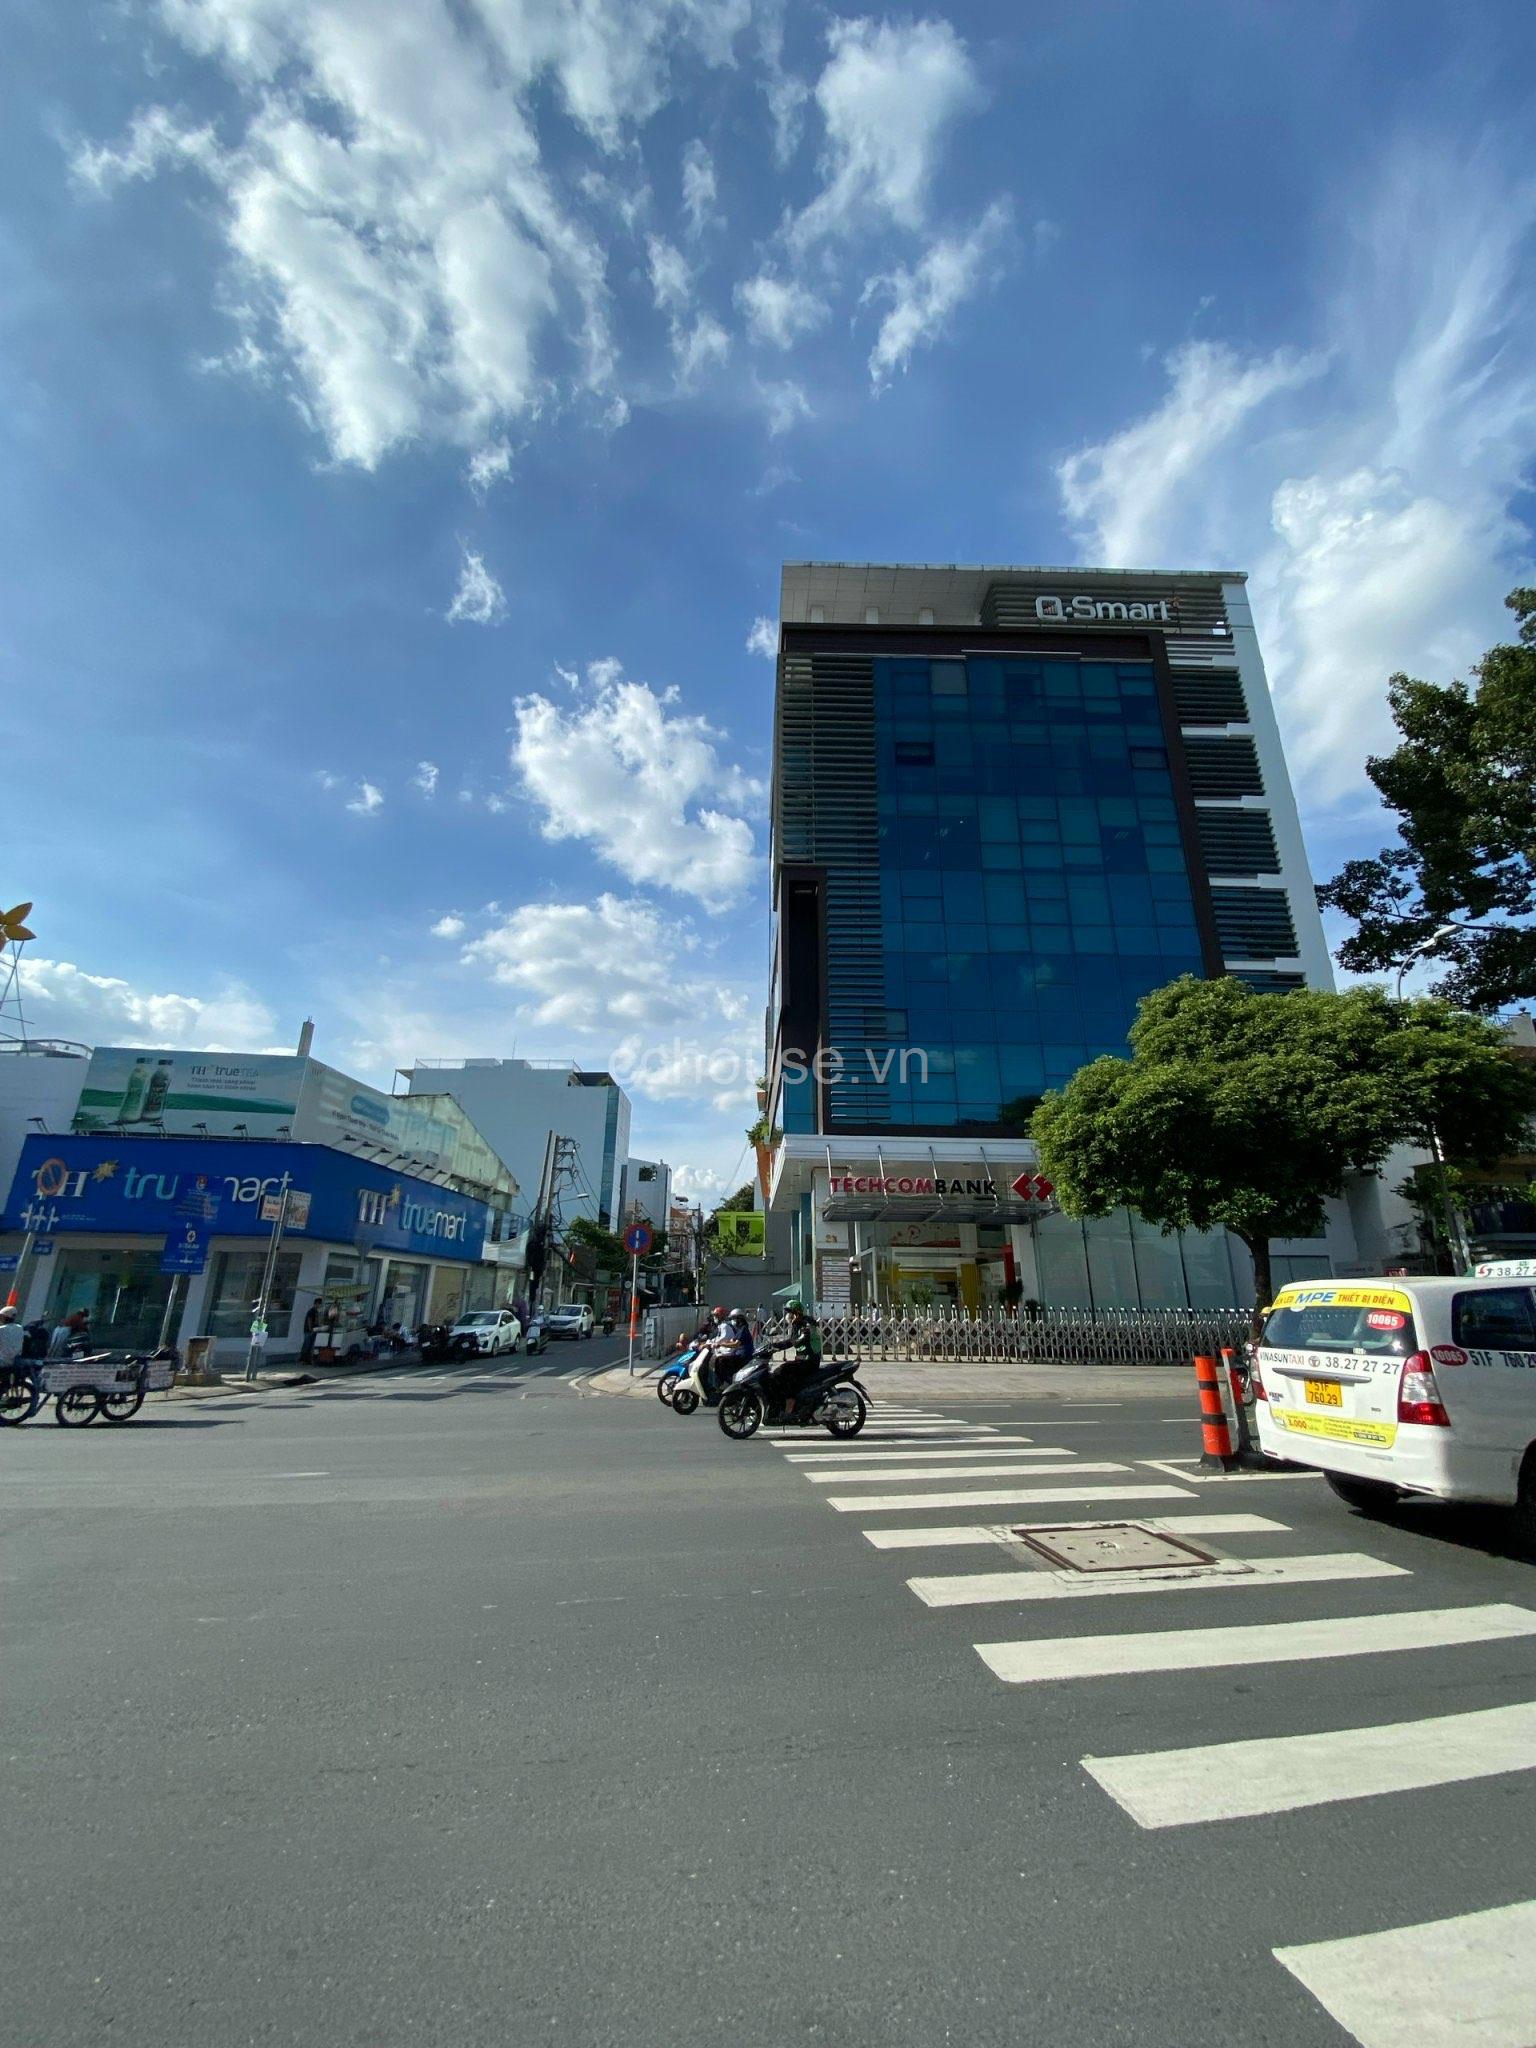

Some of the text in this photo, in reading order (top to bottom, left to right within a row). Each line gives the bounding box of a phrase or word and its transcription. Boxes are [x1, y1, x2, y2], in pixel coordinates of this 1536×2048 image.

[830, 1176, 996, 1195] TECHCOMBANK
[358, 1189, 389, 1225] TH
[1295, 1291, 1337, 1304] MPE
[1367, 1314, 1399, 1327] 10065
[1325, 1356, 1359, 1371] 38.27
[1362, 1360, 1378, 1373] 27
[1382, 1363, 1400, 1375] 27
[1468, 1350, 1493, 1367] 51F
